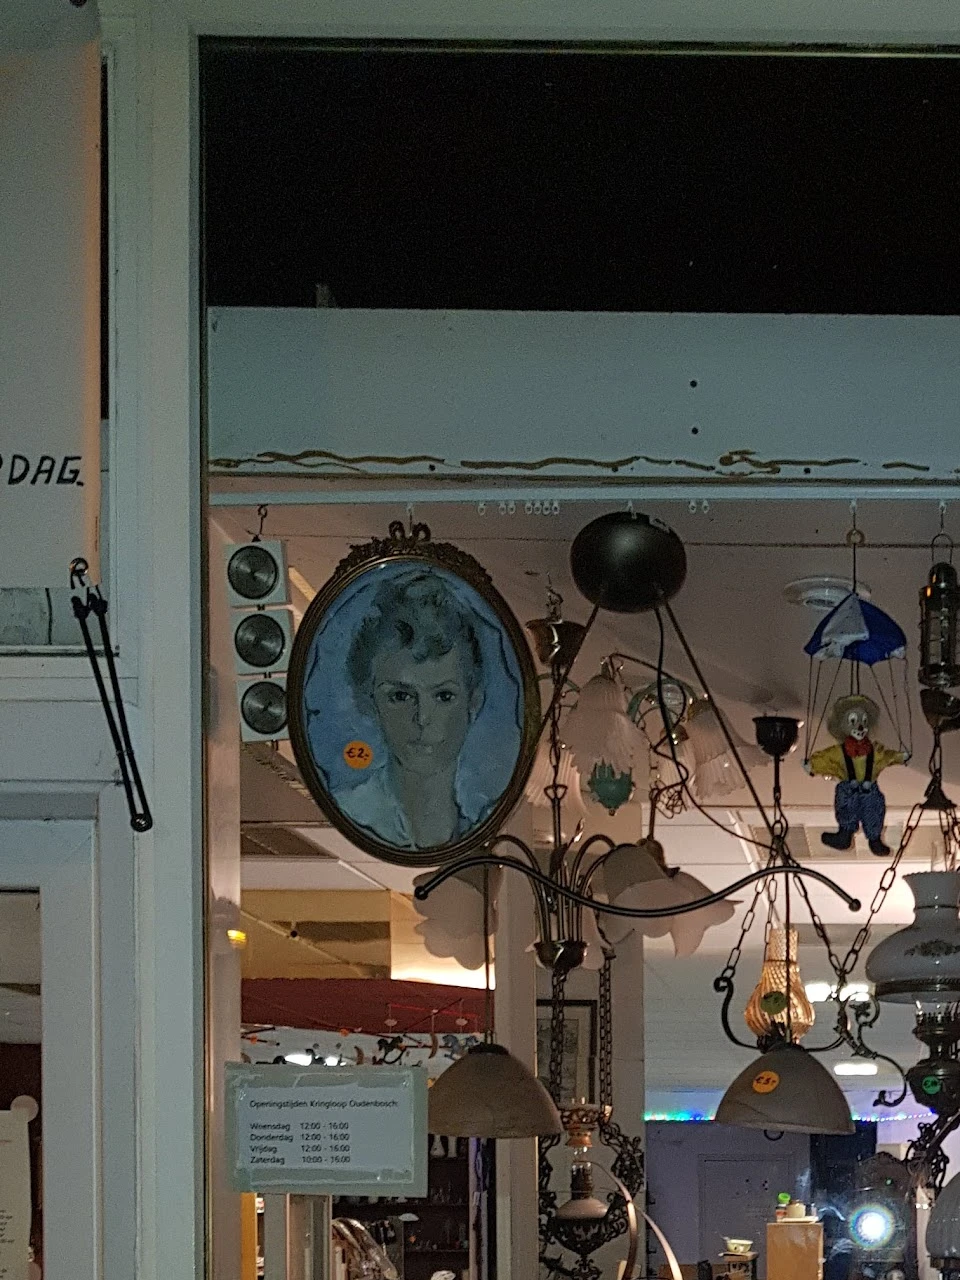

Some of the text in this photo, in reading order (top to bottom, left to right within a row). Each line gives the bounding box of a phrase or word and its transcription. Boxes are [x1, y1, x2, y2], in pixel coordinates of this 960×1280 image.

[0, 453, 84, 487] DAG.
[250, 1100, 399, 1109] Openingstijden Kringloop Oudenbosch
[250, 1123, 291, 1132] Woensdag
[300, 1122, 321, 1130] 12:00
[329, 1122, 349, 1130] 16:00
[250, 1133, 294, 1142] Donderdag
[301, 1133, 322, 1141] 12:00
[330, 1133, 350, 1141] 16:00
[250, 1145, 278, 1154] Vrijdag
[301, 1144, 322, 1152] 12:00
[329, 1144, 350, 1152] 16:00
[250, 1156, 285, 1165] Zaterdag
[302, 1156, 323, 1164] 10:00
[330, 1156, 351, 1164] 16:00
